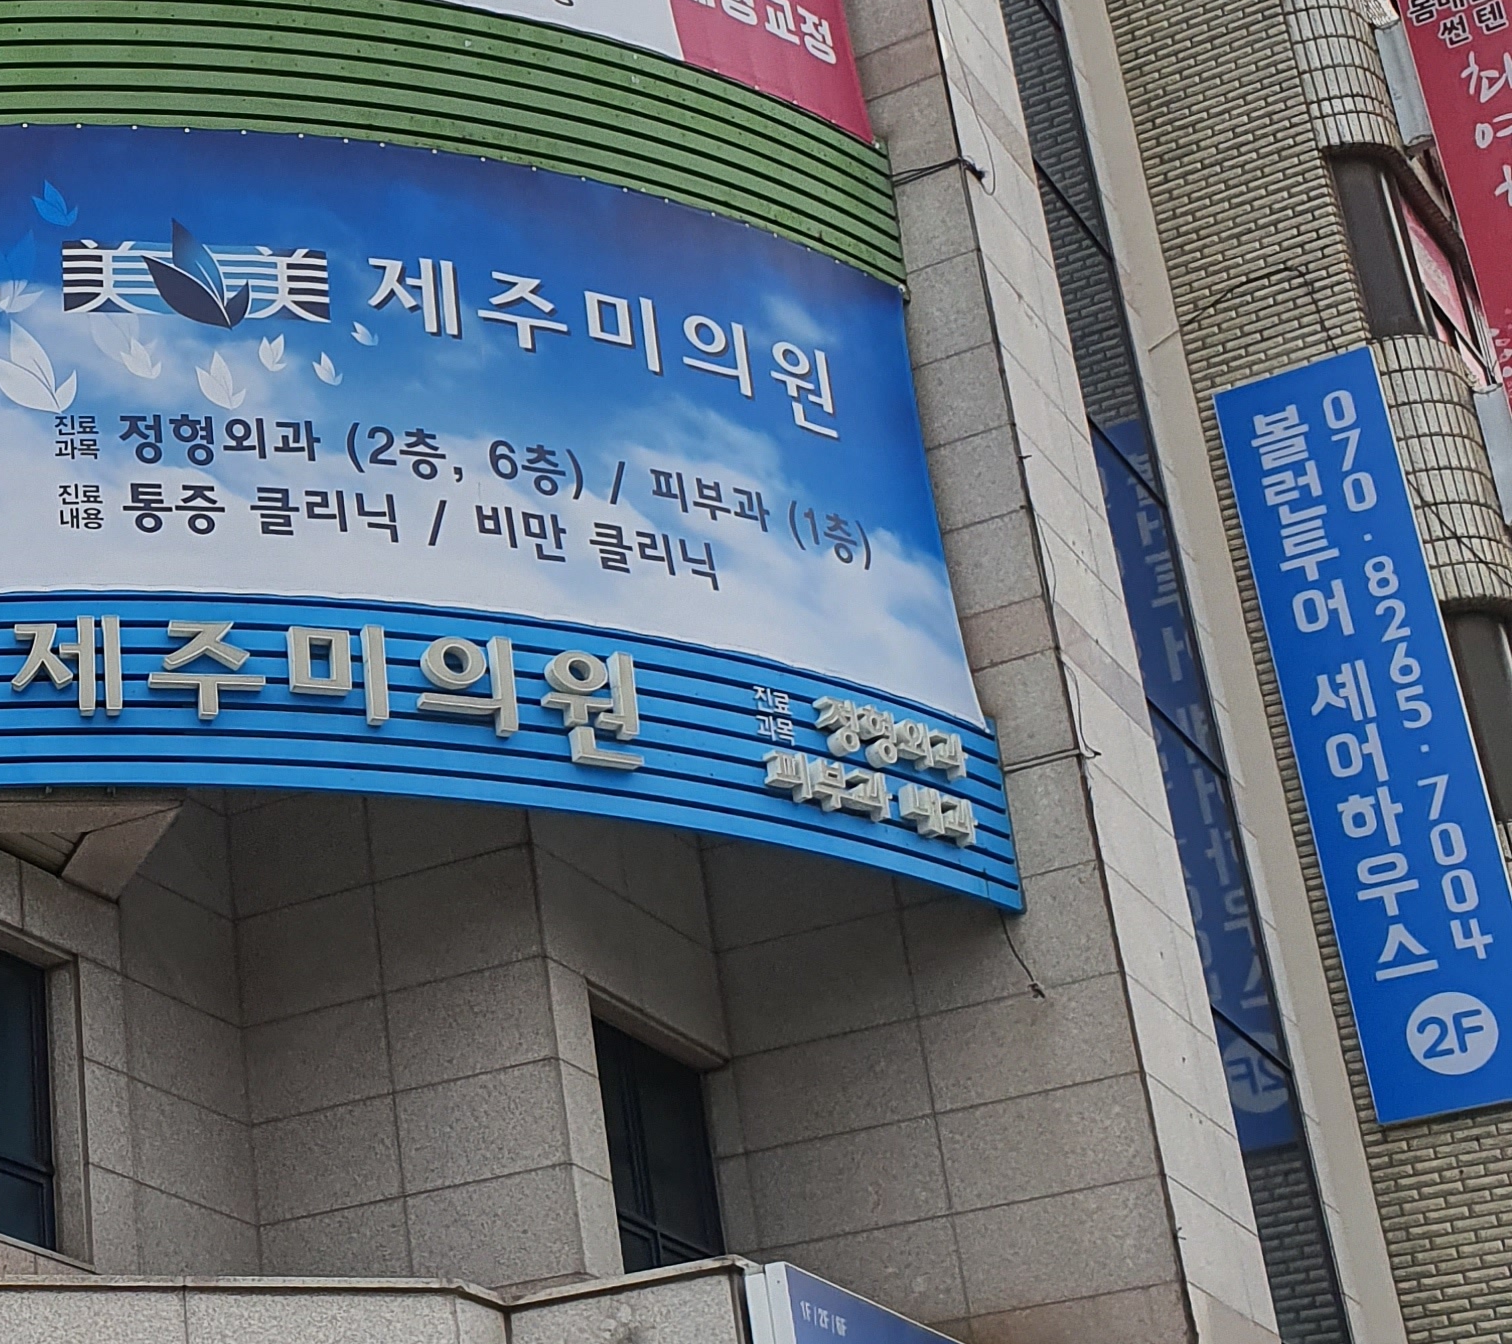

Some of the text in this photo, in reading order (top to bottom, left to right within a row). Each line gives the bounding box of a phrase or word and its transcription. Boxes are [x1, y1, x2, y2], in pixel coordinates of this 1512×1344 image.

[366, 256, 841, 441] 제주미의원
[54, 413, 99, 438] 진료
[54, 438, 101, 462] 과목
[57, 507, 105, 532] 내용
[58, 482, 103, 507] 진료
[119, 411, 322, 468] 정형외과
[345, 418, 464, 482] (2층,
[489, 436, 585, 502] 6층)
[649, 464, 771, 534] 피부과
[788, 503, 875, 574] (1층)
[122, 482, 227, 534] 통증
[257, 486, 401, 545] 클리닉
[475, 505, 567, 563] 비만
[587, 520, 723, 592] 클리닉
[8, 614, 645, 773] 제주미의원
[752, 685, 790, 716] 진료
[1249, 402, 1439, 984] 볼런투어 셰어하우스
[756, 715, 796, 747] 과목
[812, 695, 968, 783] 정형외과
[762, 748, 979, 849] 피부과 내과
[1412, 1011, 1487, 1064] 2F
